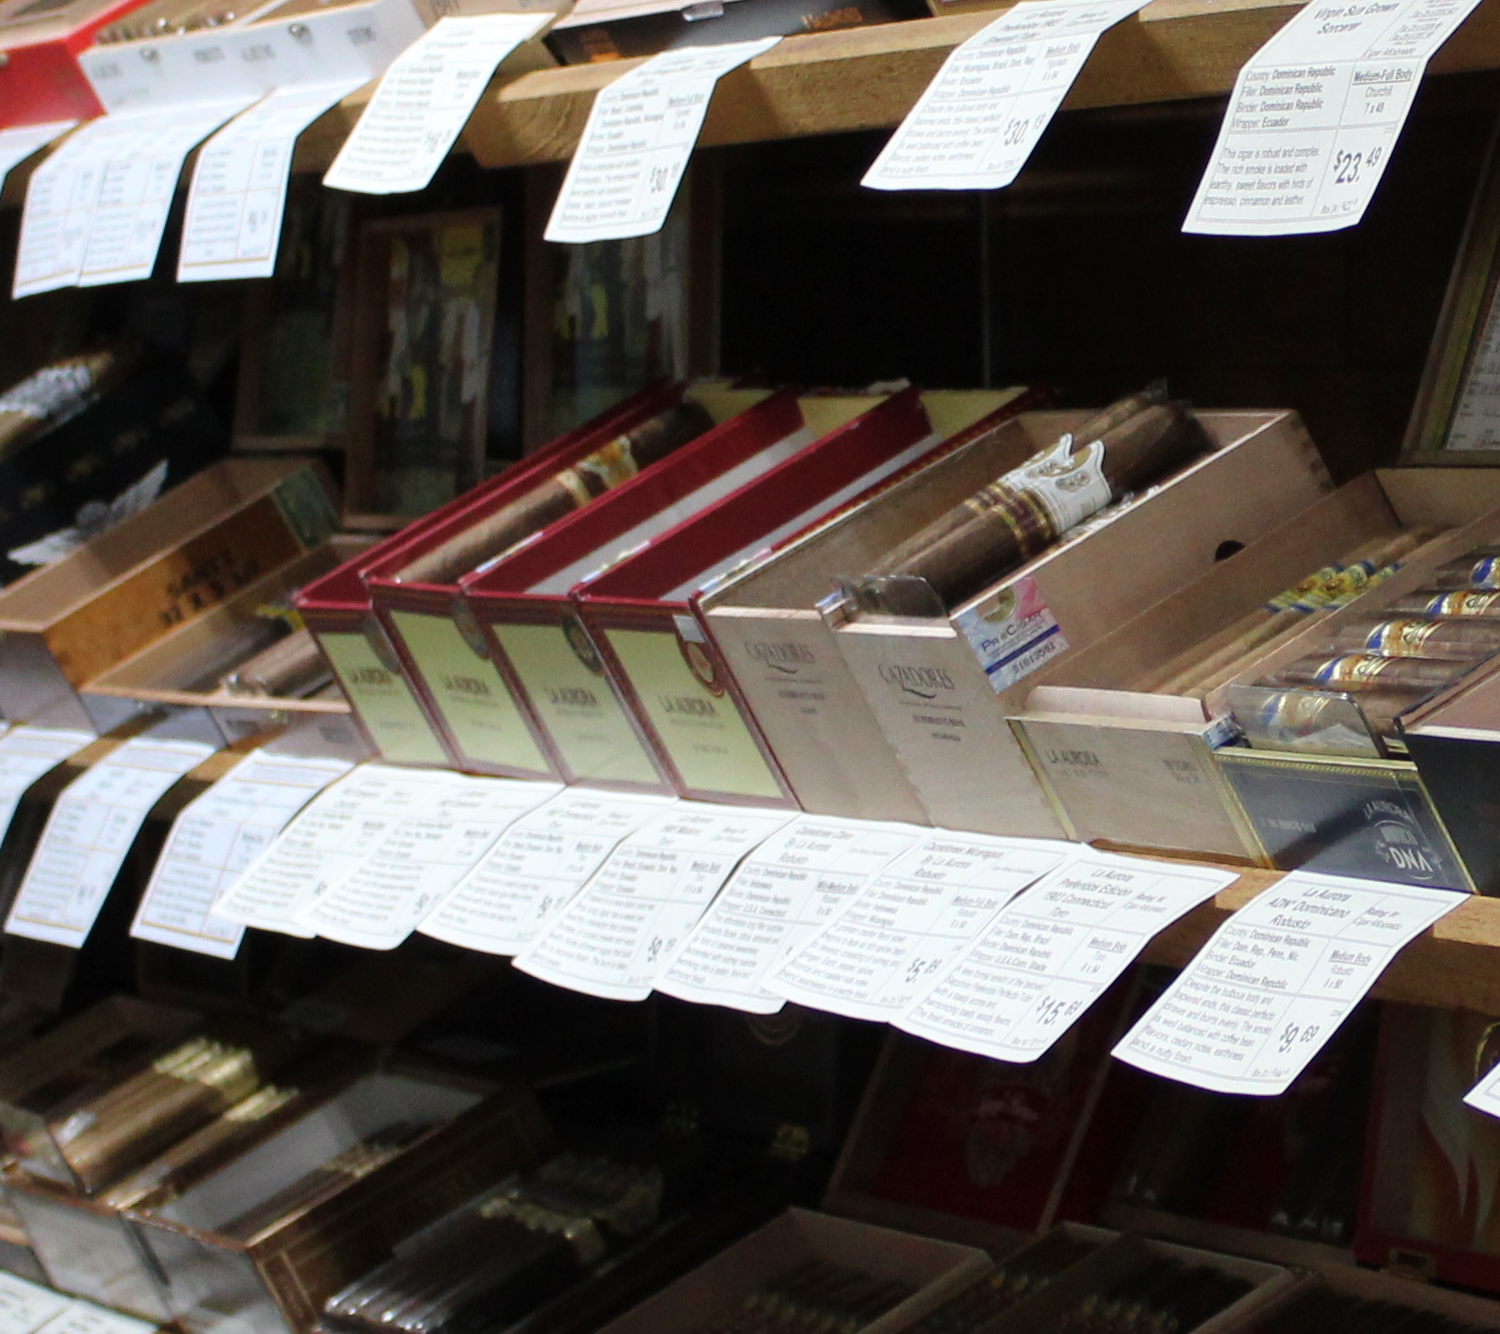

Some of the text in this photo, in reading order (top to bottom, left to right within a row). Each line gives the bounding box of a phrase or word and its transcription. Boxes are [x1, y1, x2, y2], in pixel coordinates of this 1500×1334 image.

[1331, 145, 1383, 186] $23.49
[878, 662, 955, 692] CAZADORES
[1388, 846, 1433, 873] DNA
